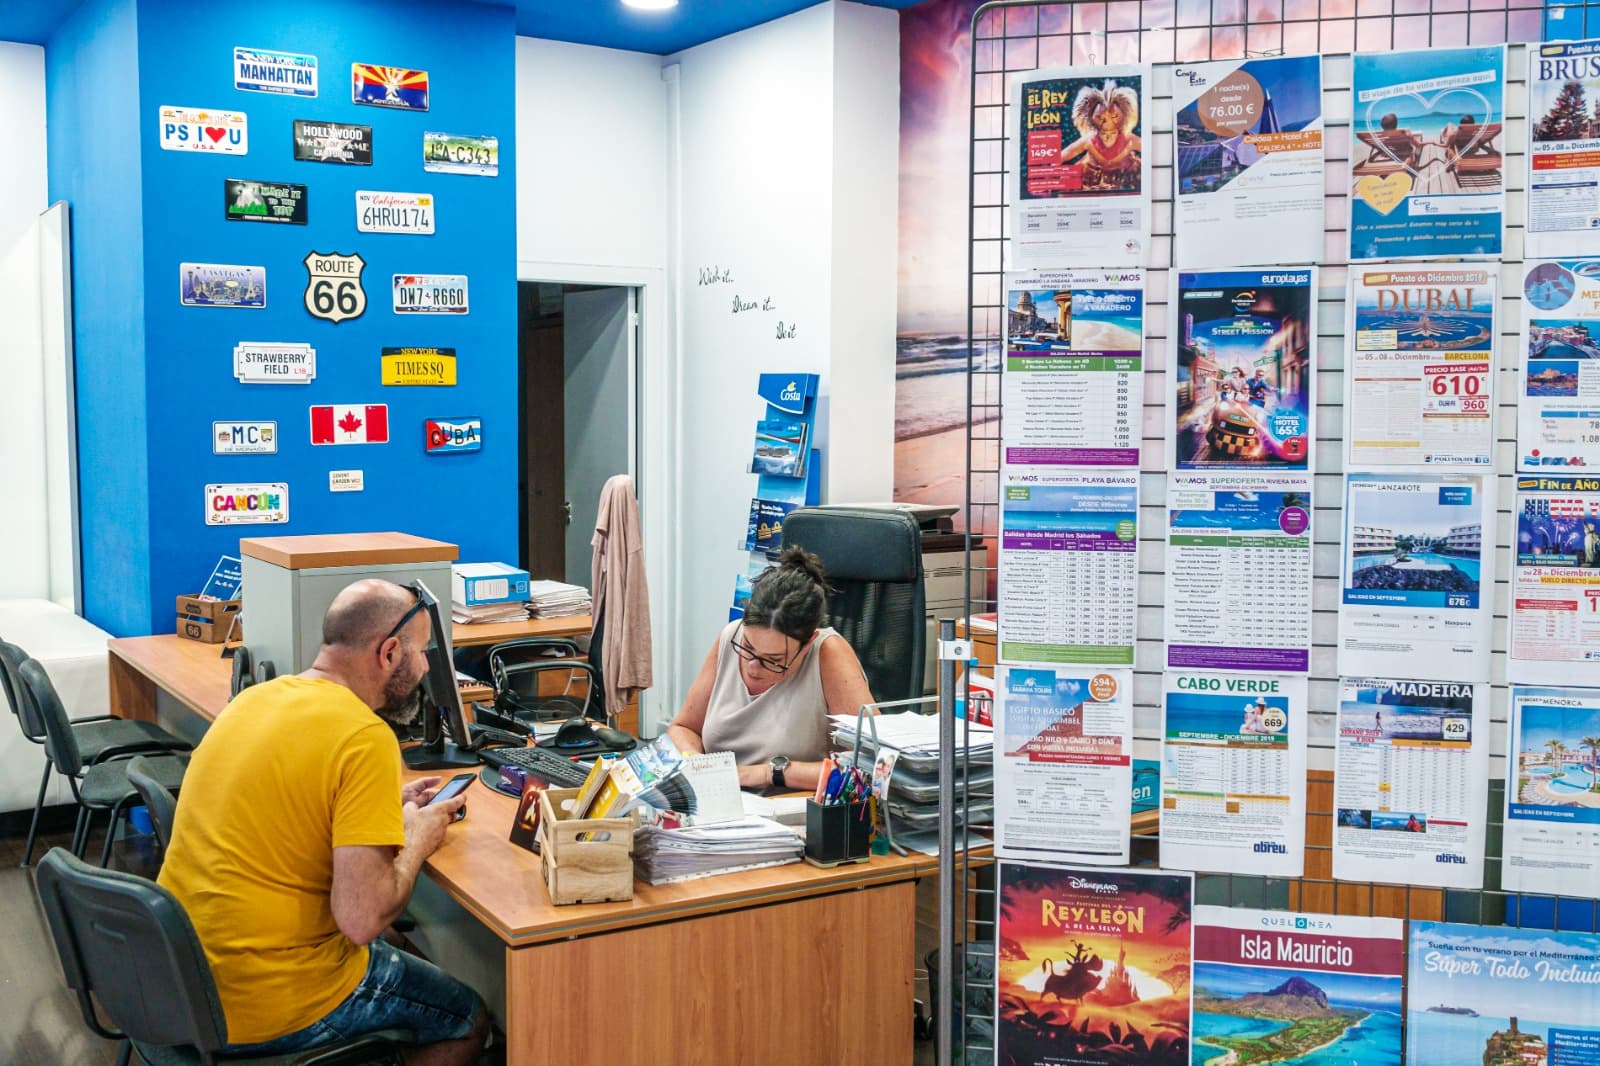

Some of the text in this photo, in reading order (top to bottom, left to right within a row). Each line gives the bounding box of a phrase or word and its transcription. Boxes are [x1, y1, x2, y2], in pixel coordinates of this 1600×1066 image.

[240, 62, 313, 86] MANHATTAN
[1027, 88, 1068, 108] EL REY
[1027, 106, 1061, 129] LEÓN
[1209, 103, 1255, 118] 76.00 €
[165, 123, 241, 145] PS I U
[303, 125, 363, 141] HOLLYWOOD
[363, 206, 430, 228] 6HRU174
[315, 259, 355, 274] ROUTE
[1105, 273, 1141, 282] WAMOS
[1391, 273, 1416, 283] Puente
[1427, 272, 1464, 282] Diciembre
[313, 280, 358, 315] 66
[433, 288, 464, 306] R660
[732, 294, 758, 314] Dream
[1376, 287, 1474, 312] DUBAI
[787, 323, 797, 339] it
[245, 352, 307, 364] STRAWBERRY
[1394, 352, 1431, 361] Diciembre
[1444, 352, 1490, 361] BARCELONA
[264, 364, 289, 375] FIELD
[395, 361, 444, 379] TIMES SQ
[1432, 375, 1480, 396] 610
[780, 388, 801, 401] Costa
[1463, 400, 1485, 410] 960
[430, 424, 477, 447] CUBA
[1210, 477, 1266, 485] SUPEROFERTA
[1377, 484, 1421, 492] LANZAROTE
[1538, 479, 1560, 490] FIN
[1574, 477, 1600, 491] AÑO
[212, 491, 281, 512] CANCÚN
[1532, 568, 1593, 577] 28 Diciembre
[1177, 676, 1279, 693] CABO VERDE
[1391, 682, 1473, 698] MADEIRA
[1542, 698, 1583, 707] MENORCA
[1264, 718, 1283, 728] 669
[1445, 724, 1465, 733] 429
[1041, 898, 1144, 934] REY LEÓN
[1098, 925, 1121, 933] SELVA
[1240, 933, 1353, 967] Isla Mauricio
[1428, 940, 1595, 961] Sueña con tu verano por el Mediterráneo
[1424, 951, 1482, 978] Súper
[1484, 956, 1531, 979] Todo
